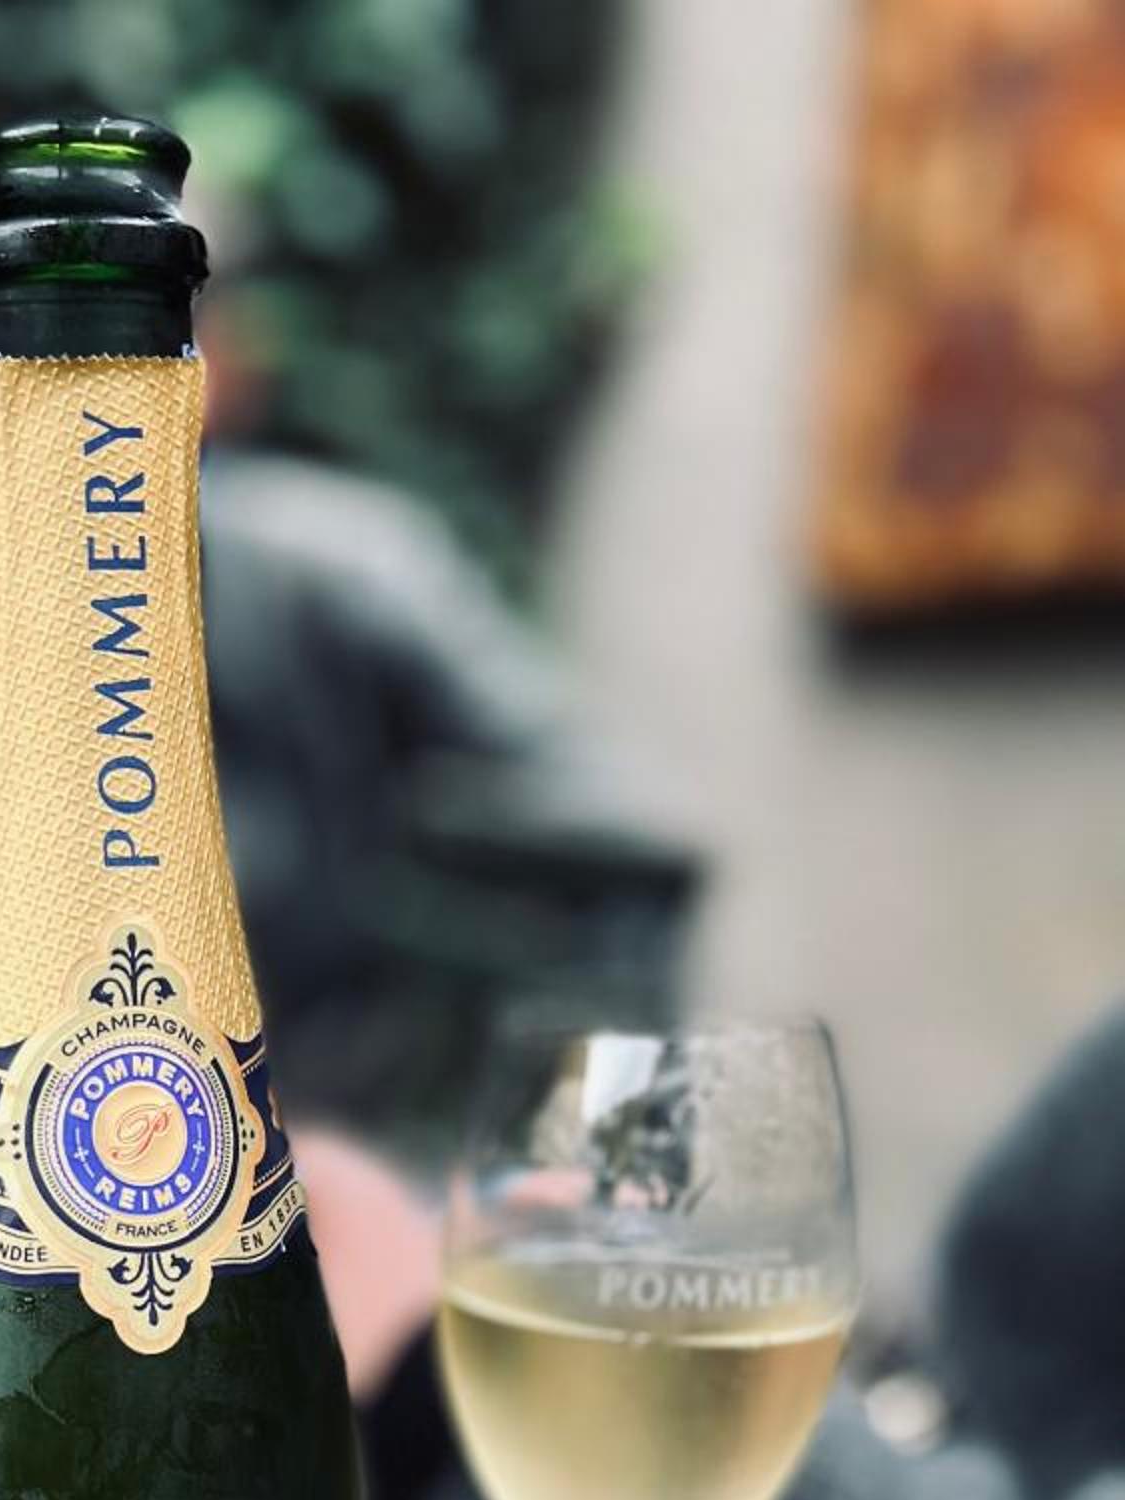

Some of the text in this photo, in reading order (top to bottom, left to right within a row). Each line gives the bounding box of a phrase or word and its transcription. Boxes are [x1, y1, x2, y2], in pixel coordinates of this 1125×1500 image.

[81, 409, 161, 869] POMMERY
[61, 1012, 207, 1057] CHAMPAGNE
[70, 1055, 206, 1121] POMMERY
[94, 1172, 193, 1211] REIMS
[115, 1219, 179, 1238] FRANCE
[240, 1230, 264, 1253] EN
